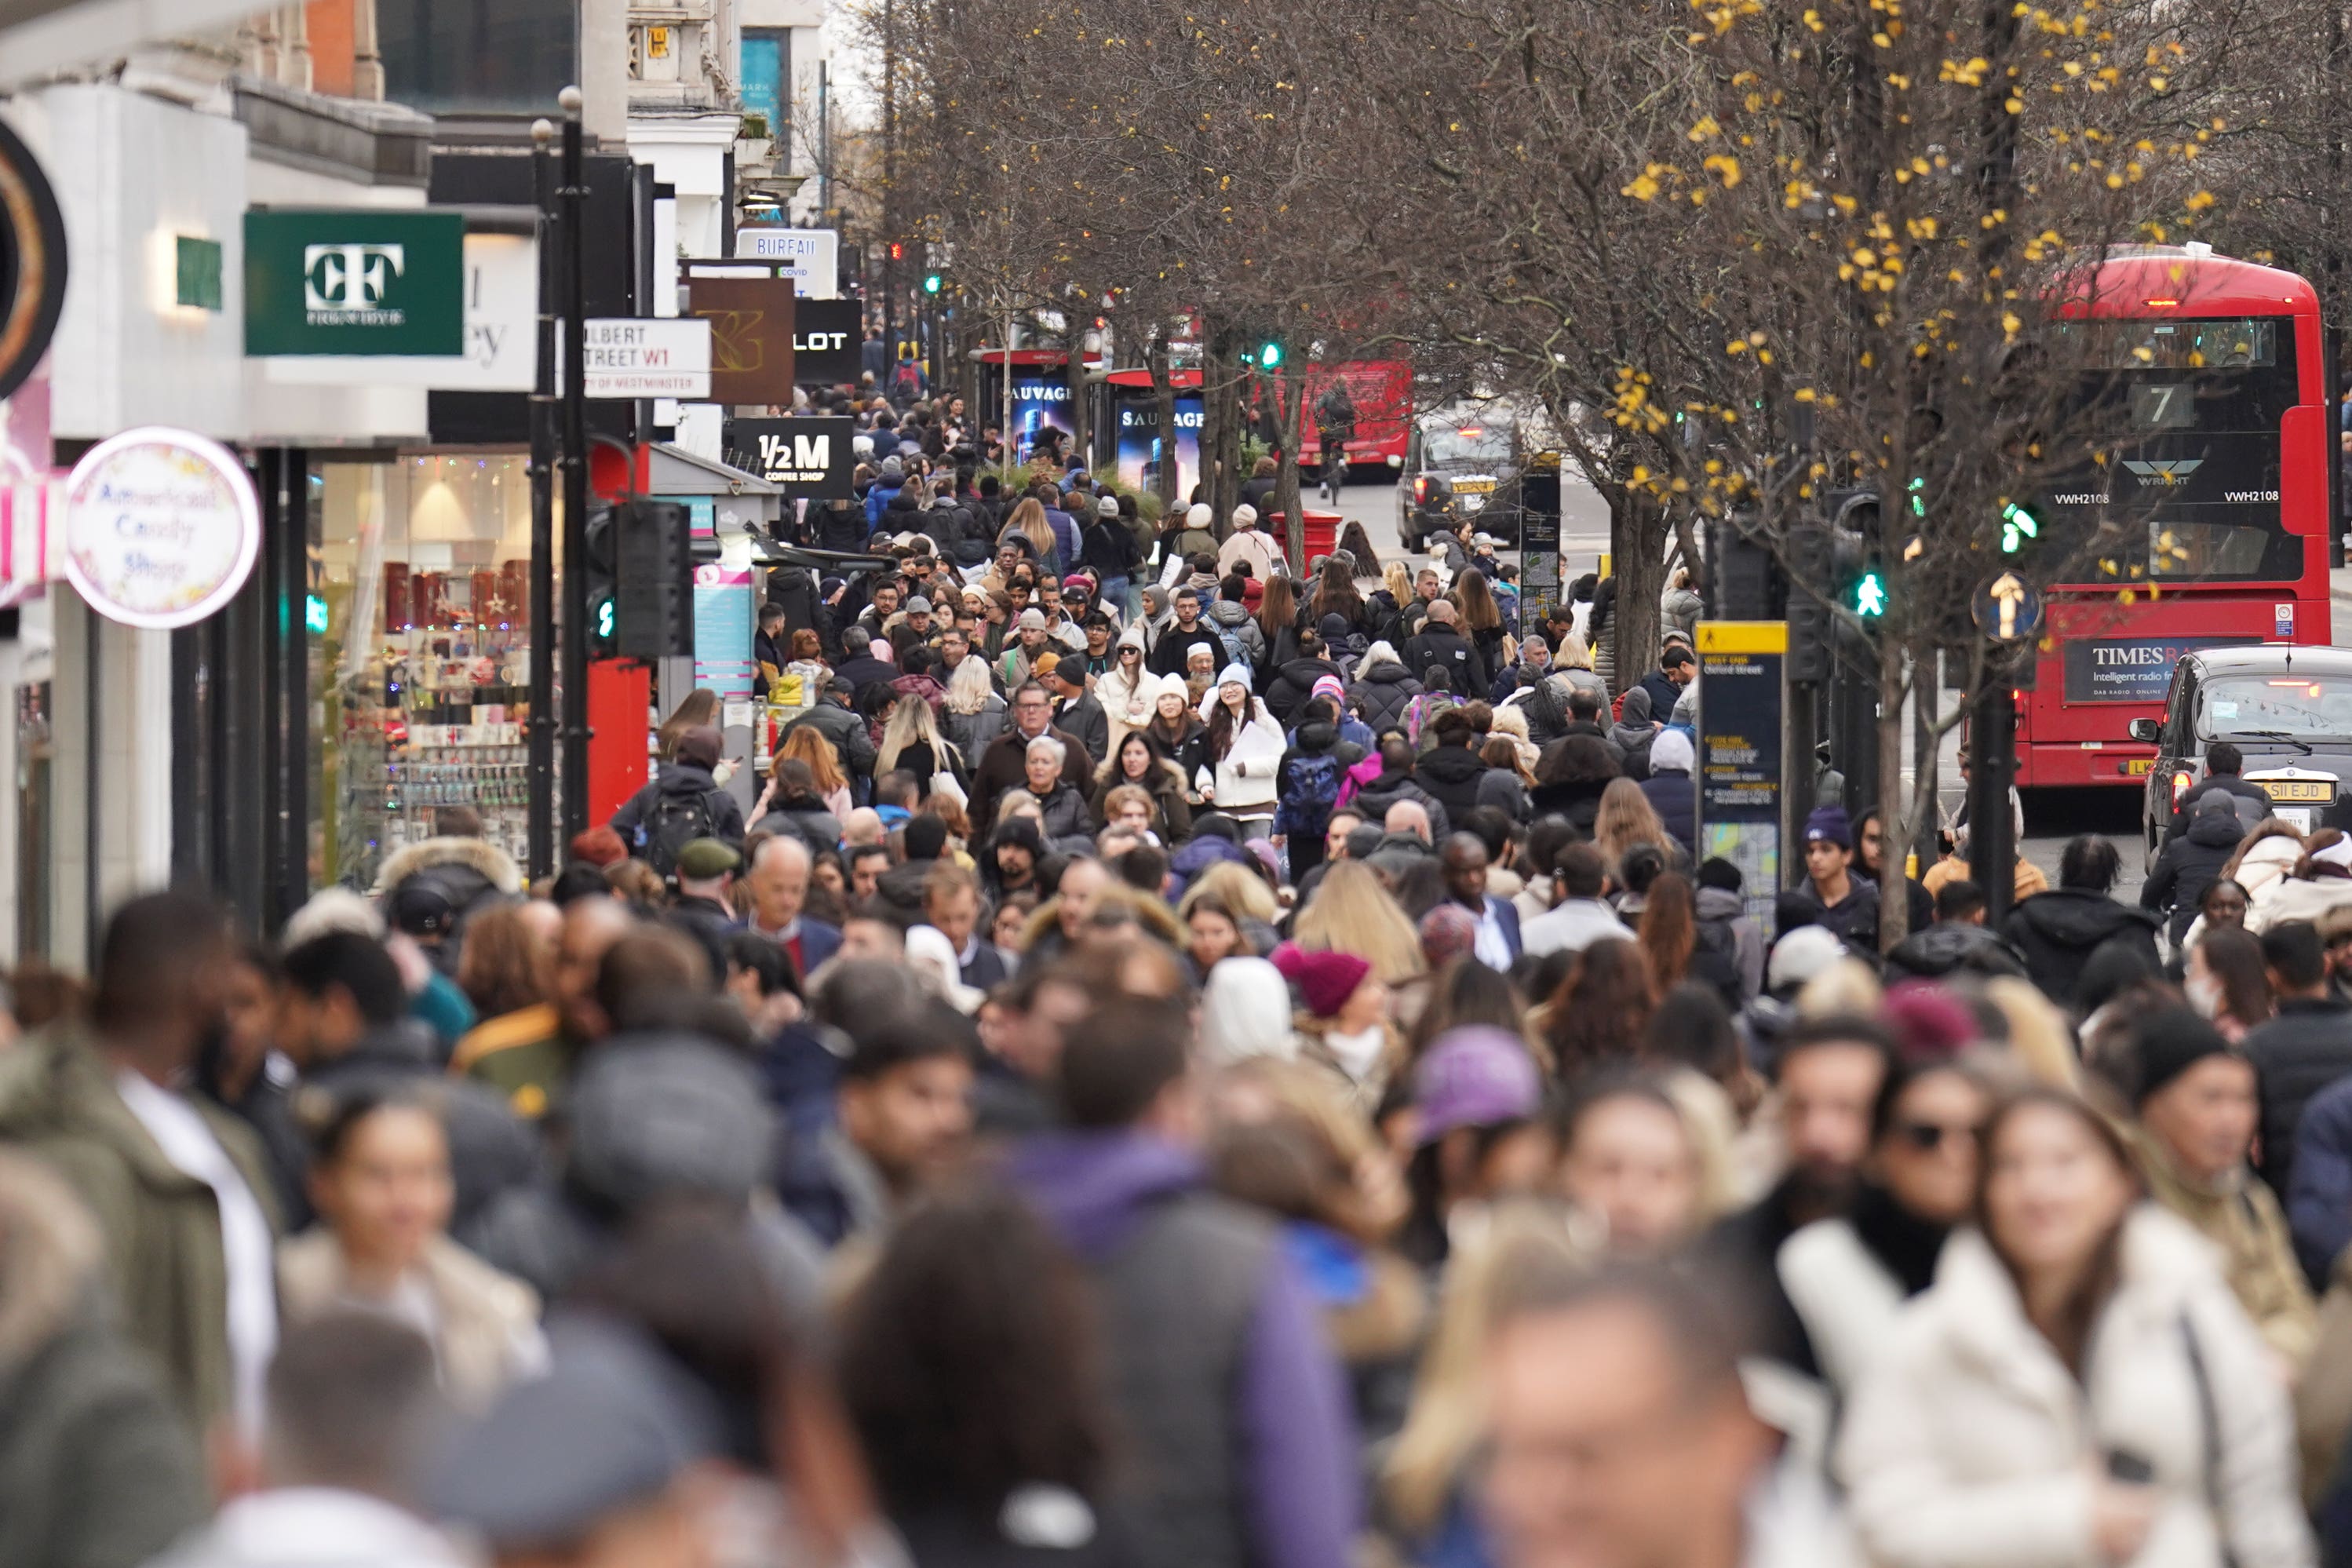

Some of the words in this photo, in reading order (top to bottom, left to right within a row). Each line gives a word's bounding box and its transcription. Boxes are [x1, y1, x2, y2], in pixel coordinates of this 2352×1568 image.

[584, 326, 646, 345] ILBERT
[793, 333, 848, 350] LOT
[583, 349, 638, 367] TREET
[642, 349, 669, 366] W1
[2150, 388, 2174, 422] 7
[764, 472, 799, 481] COFFEE
[799, 472, 826, 481] SHOP
[2055, 494, 2110, 505] VWH2108
[2224, 491, 2279, 501] VWH2108
[2094, 671, 2136, 684] Intelligent
[2138, 672, 2161, 681] radio
[2292, 785, 2319, 797] EJD
